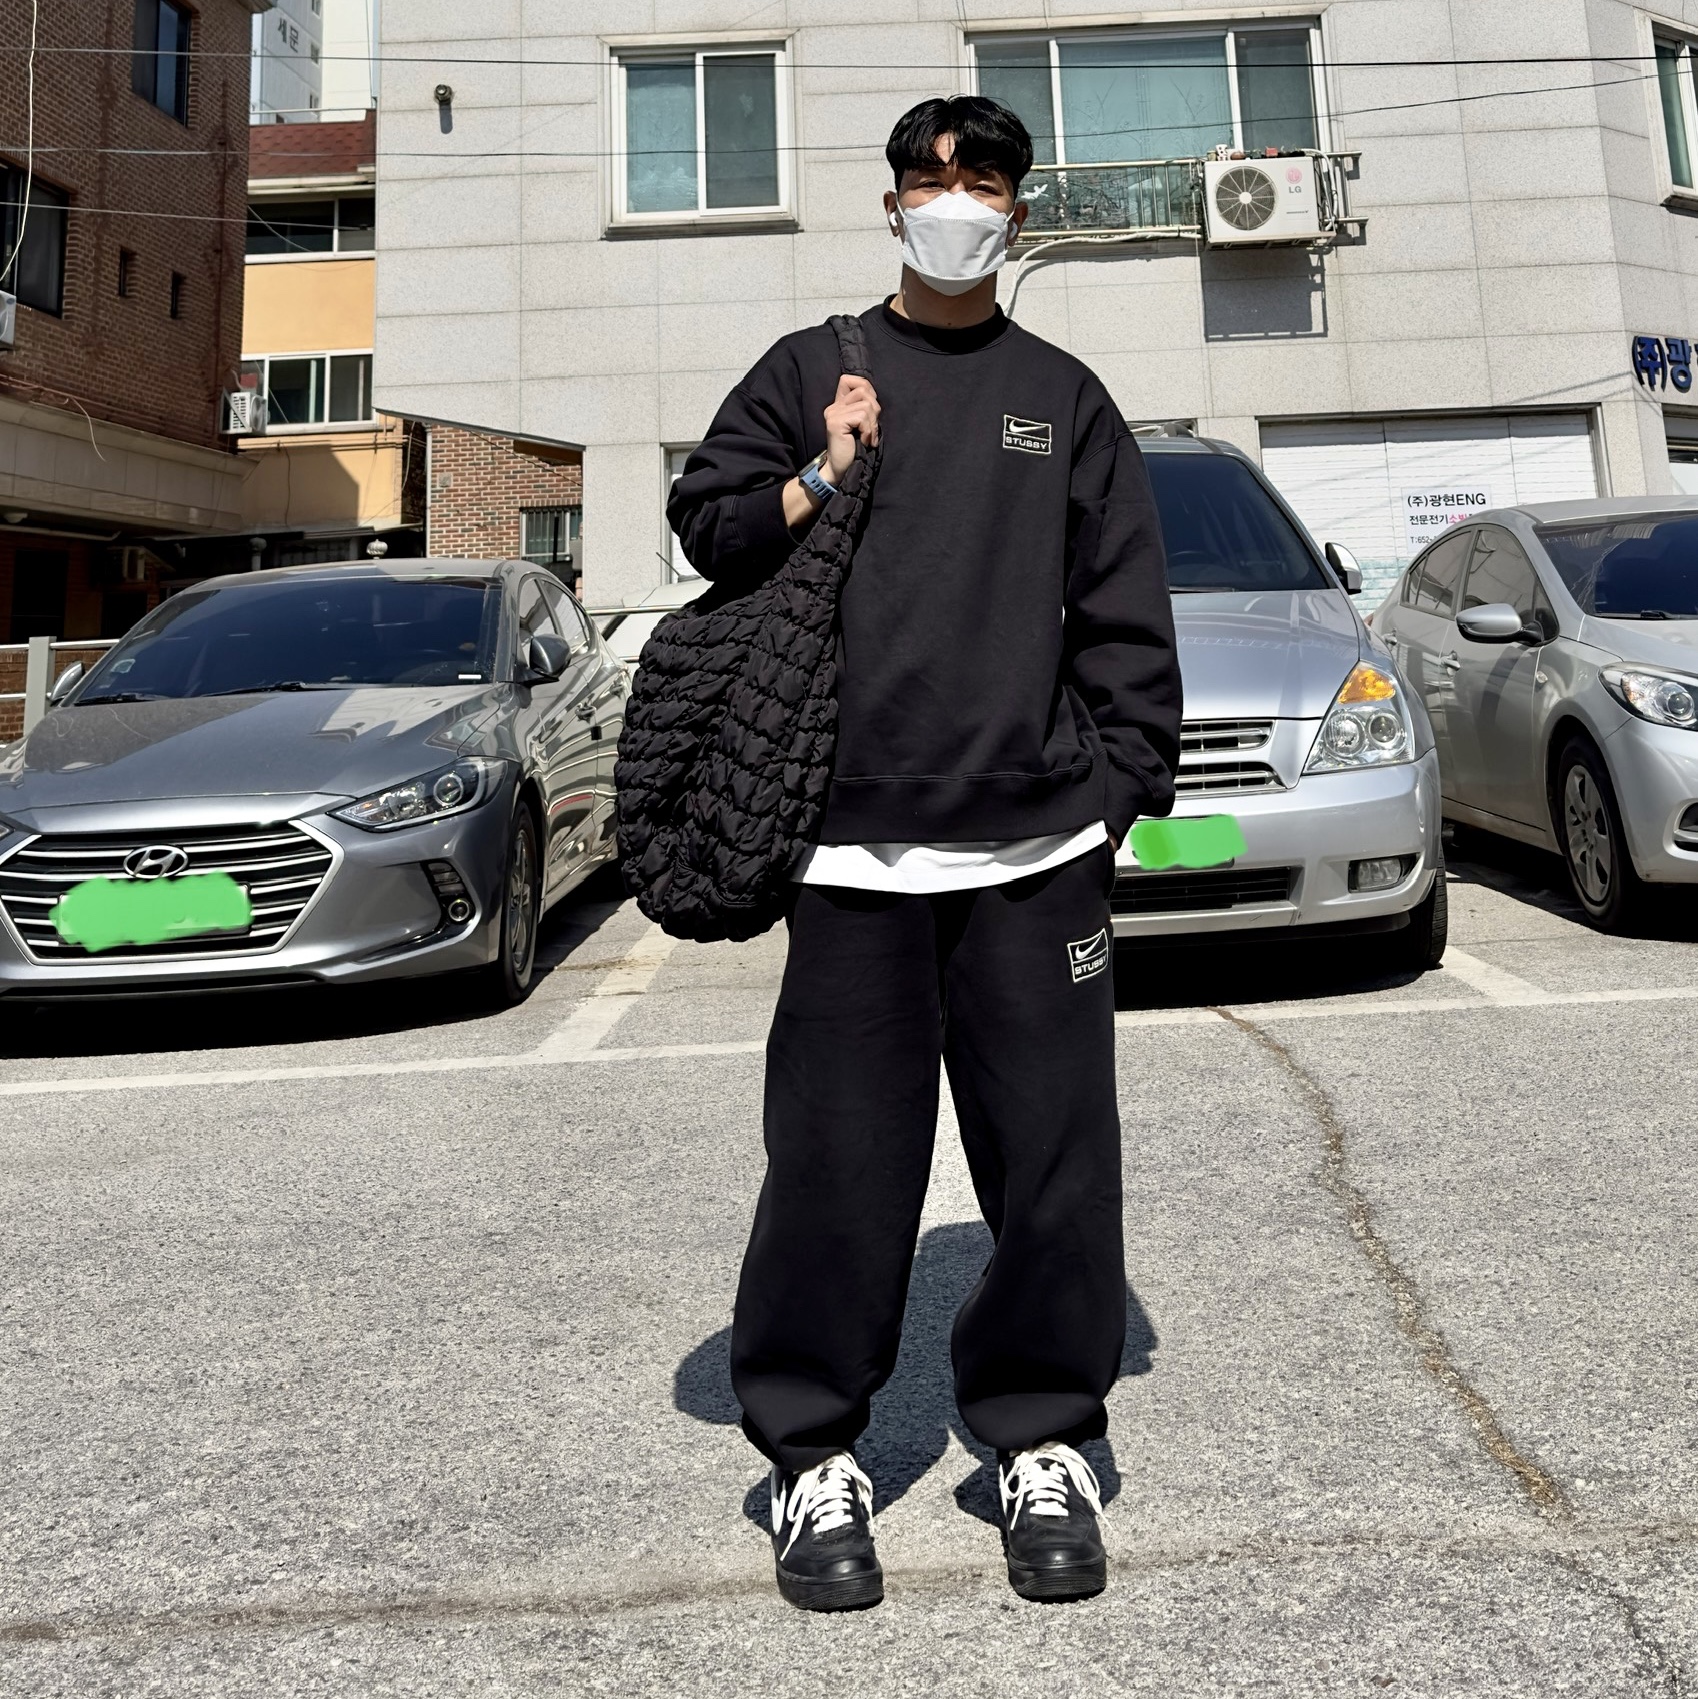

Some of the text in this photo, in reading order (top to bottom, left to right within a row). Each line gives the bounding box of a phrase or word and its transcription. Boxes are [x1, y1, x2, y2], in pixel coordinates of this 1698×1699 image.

[1289, 186, 1302, 194] LG
[1631, 335, 1698, 394] (주)광
[1005, 436, 1047, 450] STUSSY
[1407, 493, 1486, 508] (주)광현ENG
[1410, 536, 1438, 544] T:652-
[1074, 954, 1107, 975] STUSSY
